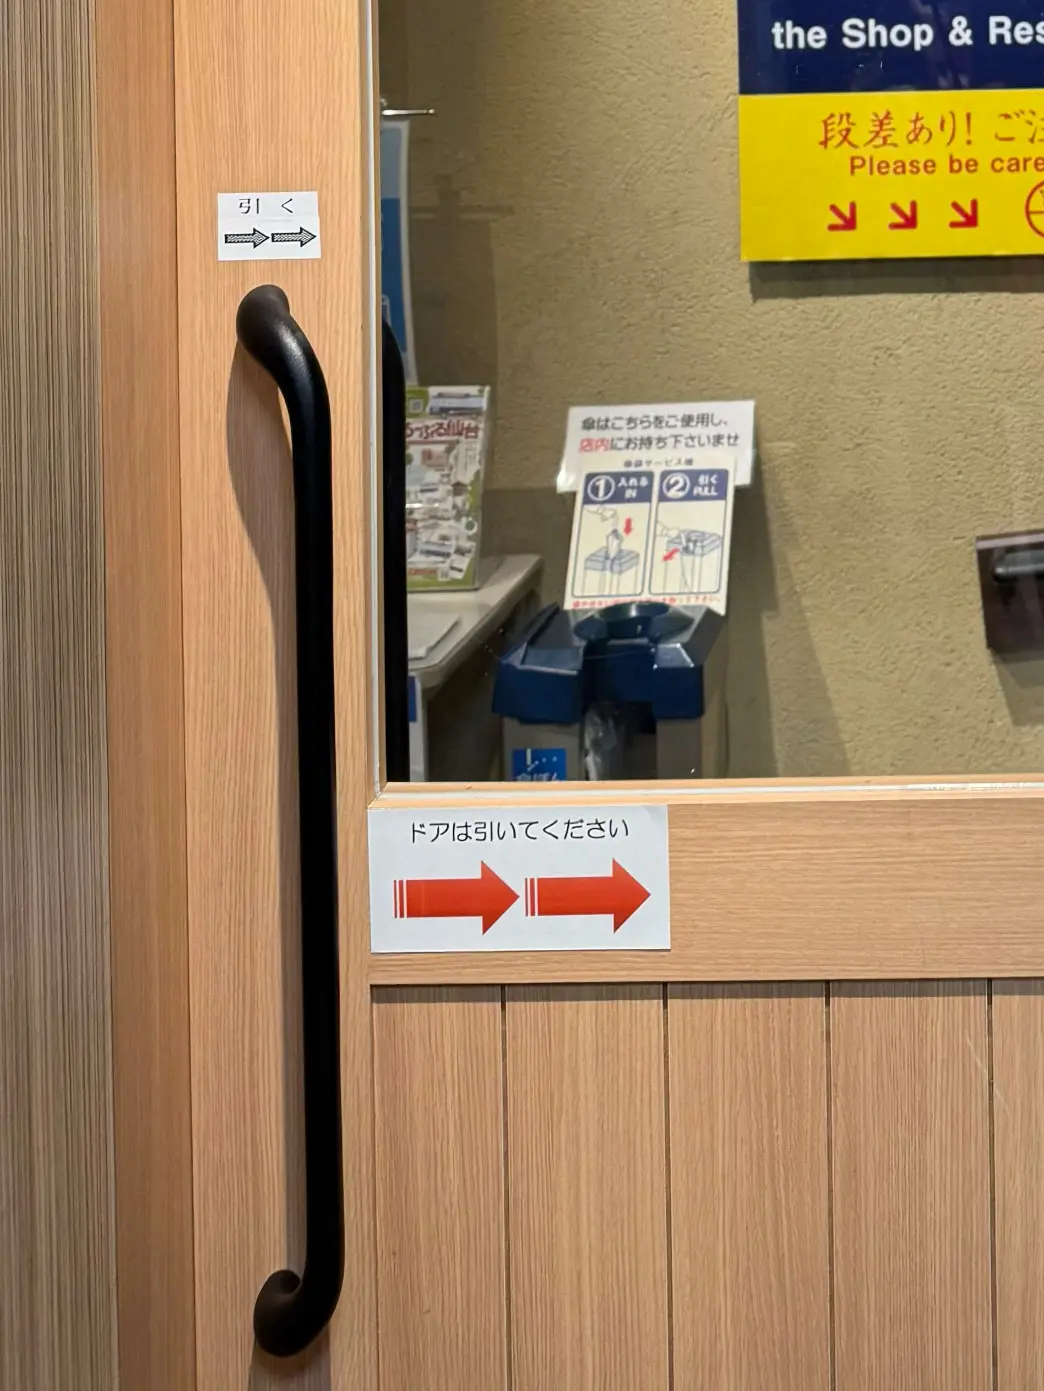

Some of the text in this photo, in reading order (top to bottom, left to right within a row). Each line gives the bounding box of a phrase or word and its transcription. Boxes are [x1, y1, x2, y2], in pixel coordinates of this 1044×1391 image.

[771, 20, 828, 49] the
[841, 16, 934, 52] Shop
[948, 16, 973, 46] &
[849, 155, 937, 176] Please
[948, 154, 979, 174] be
[578, 433, 741, 453] 店内にお持ち下さいませ
[692, 486, 718, 497] PULL
[411, 818, 630, 844] ドアは引いてください
